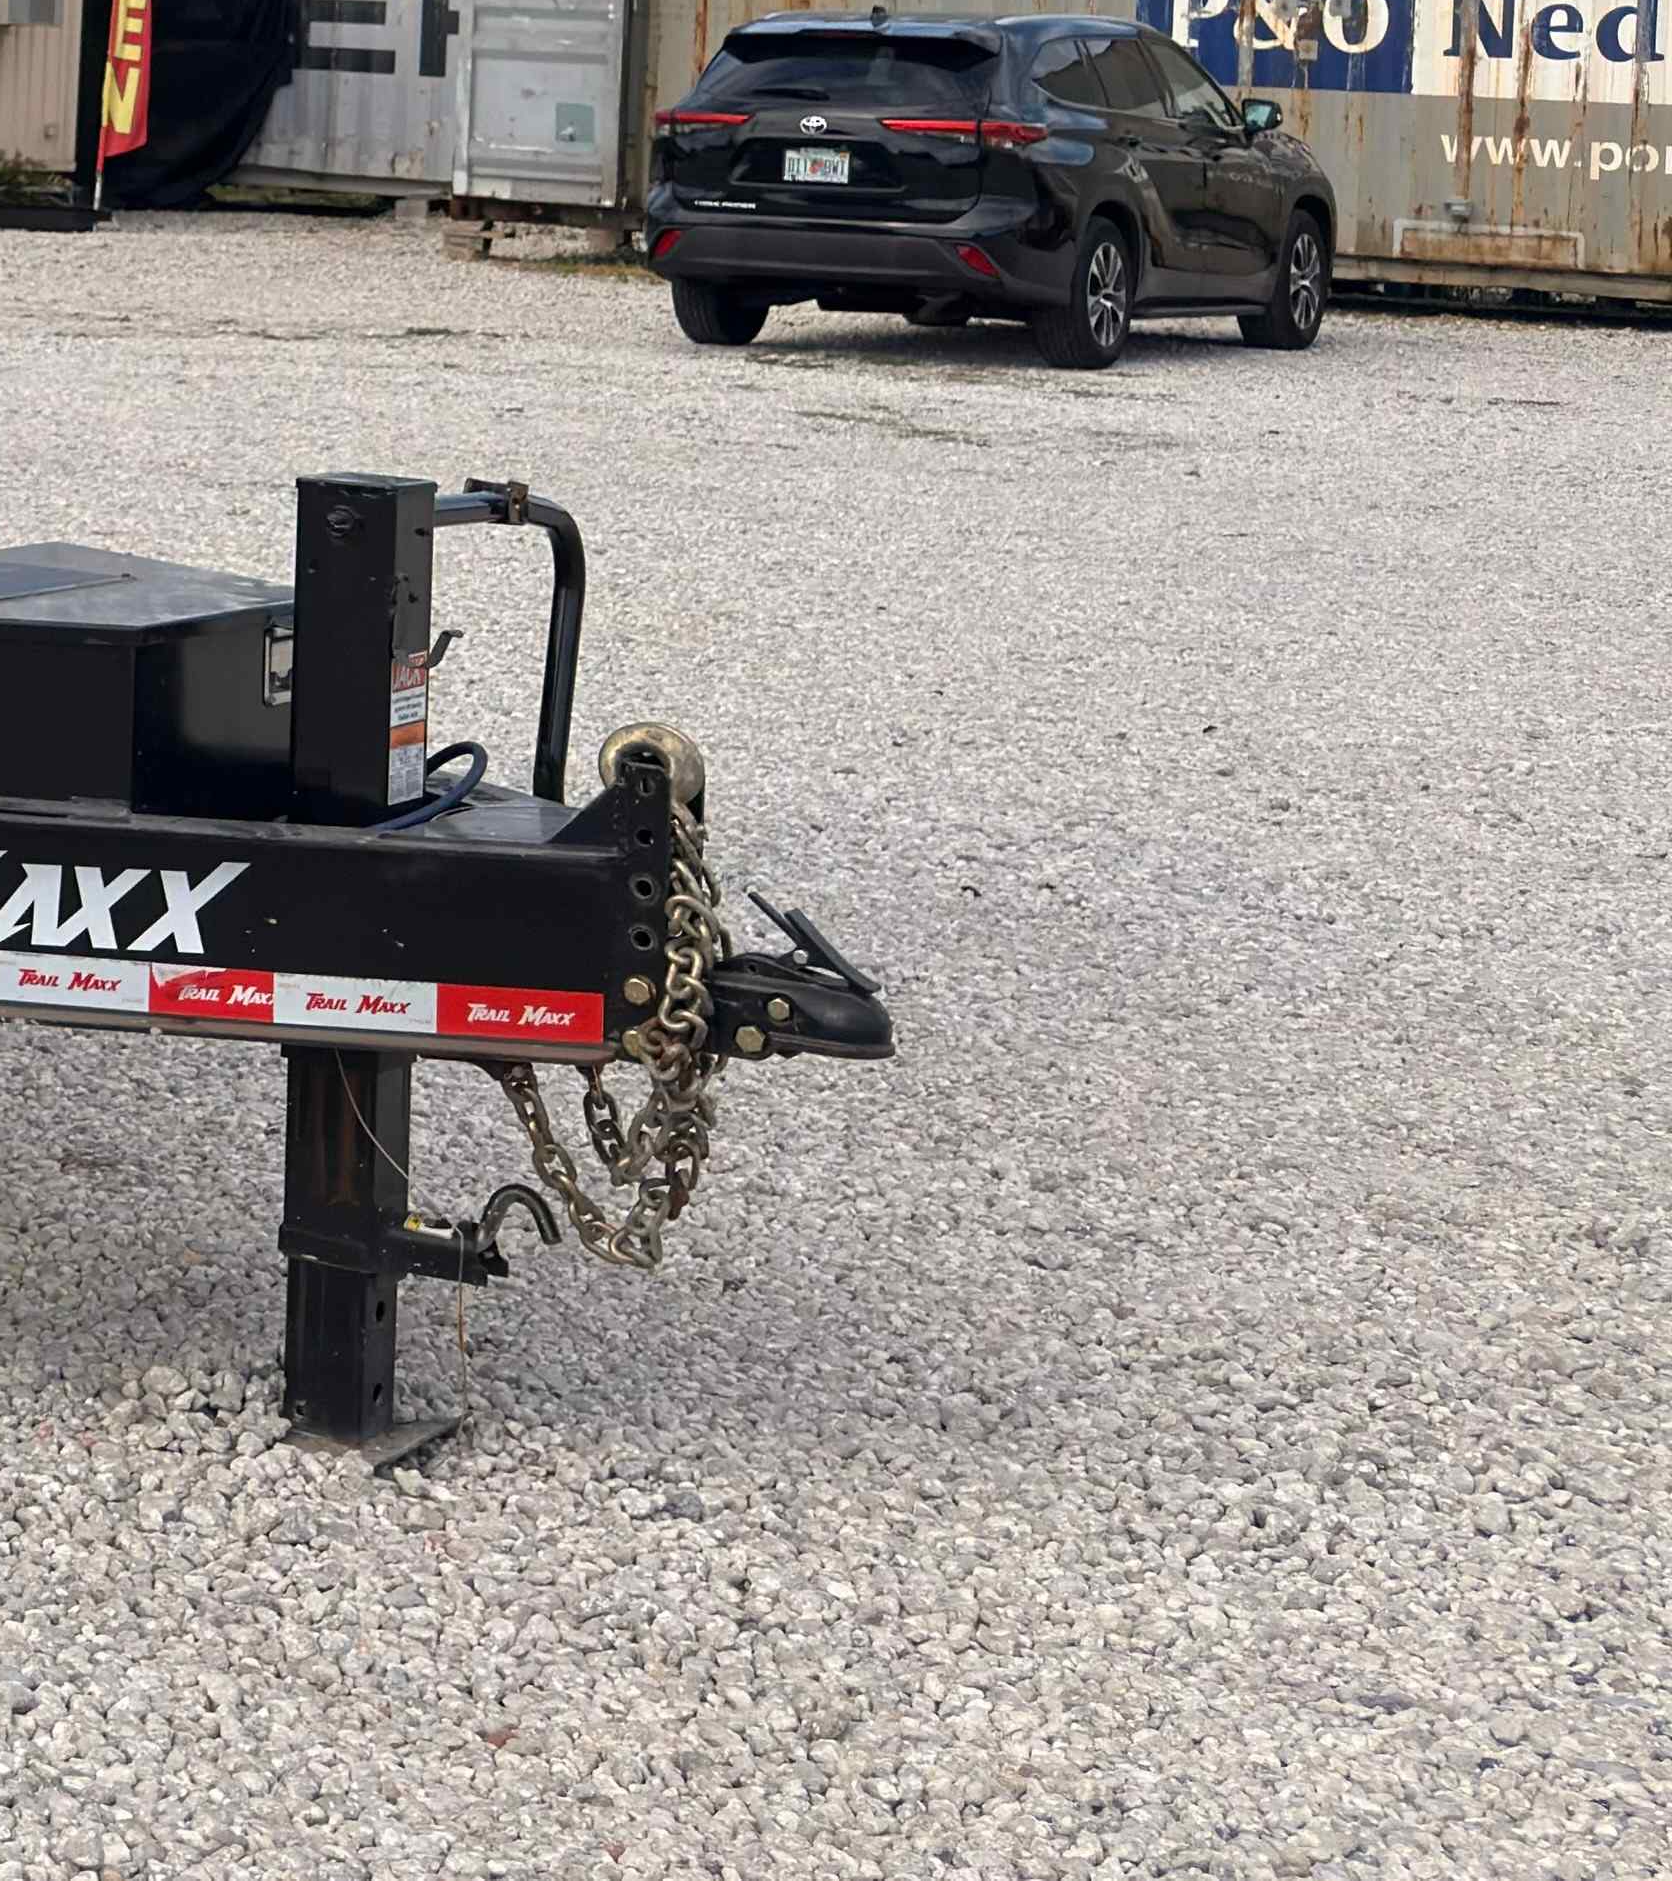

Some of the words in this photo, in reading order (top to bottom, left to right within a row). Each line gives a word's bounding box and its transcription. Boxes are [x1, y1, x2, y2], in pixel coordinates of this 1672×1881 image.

[1440, 134, 1672, 182] www.po
[18, 968, 60, 987] TRAIL
[67, 971, 121, 992] MAXX
[178, 984, 220, 1002] TRAIL
[305, 992, 348, 1012] TRAIL
[356, 995, 411, 1015] MAXX
[467, 1003, 511, 1024] TRAIL
[518, 1005, 575, 1027] MAXX
